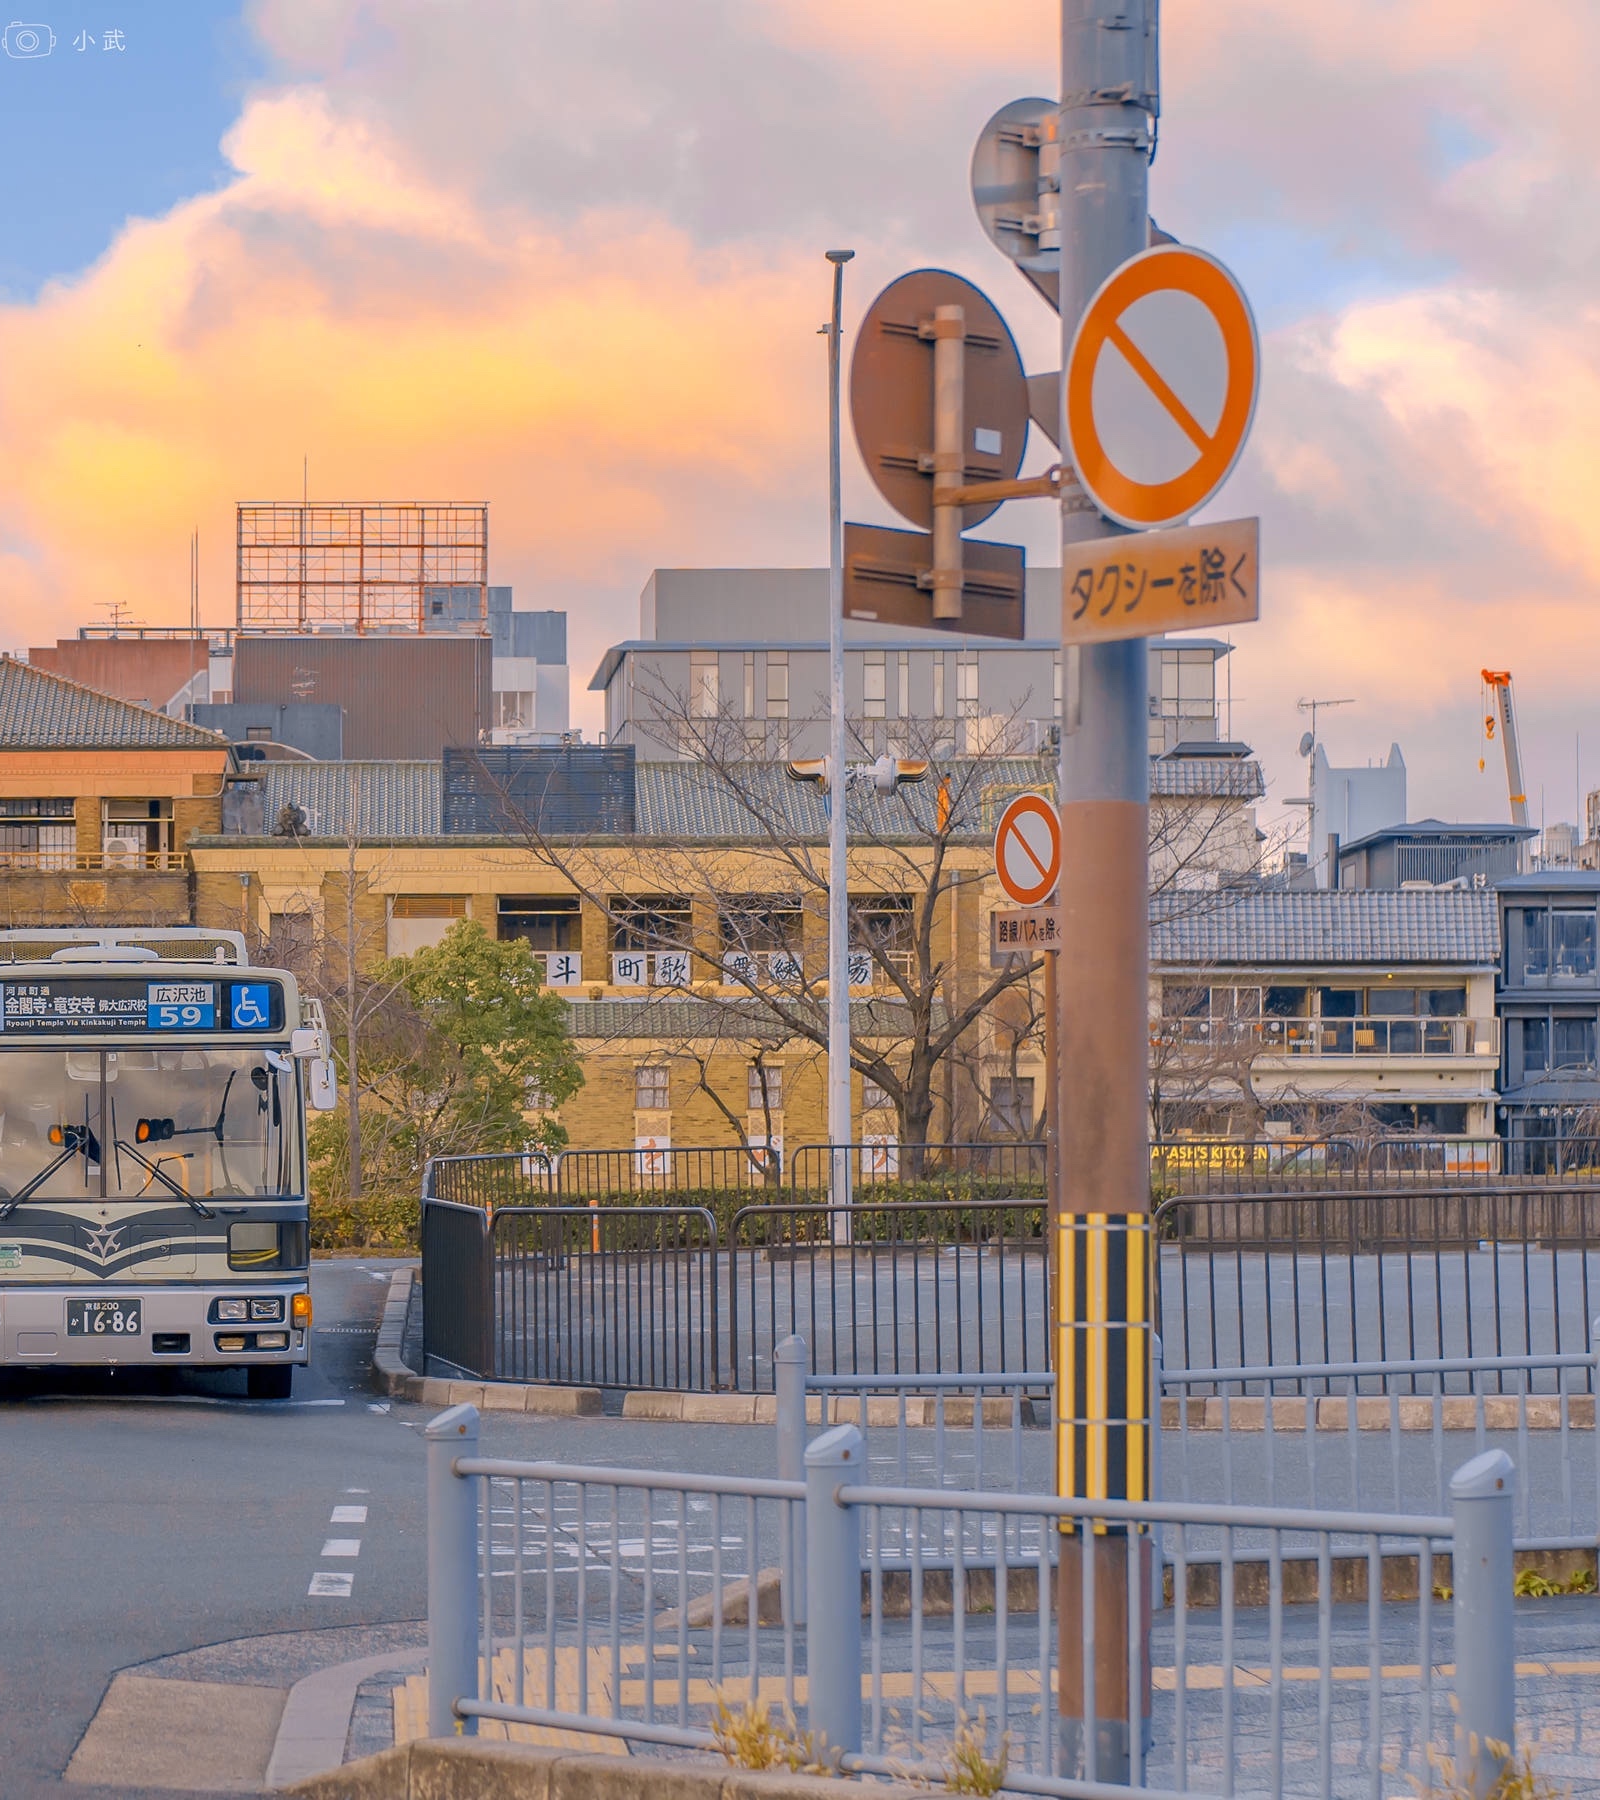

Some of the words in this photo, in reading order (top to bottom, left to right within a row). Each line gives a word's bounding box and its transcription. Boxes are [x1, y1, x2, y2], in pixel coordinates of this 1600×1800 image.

[1071, 547, 1248, 620] タクシーを除く
[156, 987, 206, 1003] 広沢池
[6, 1020, 35, 1028] Ryoanji
[37, 1019, 64, 1027] Temple
[81, 1018, 116, 1027] Kinkakuji
[119, 1018, 146, 1027] Temple
[159, 1006, 202, 1026] 59
[83, 1311, 137, 1332] 16-86
